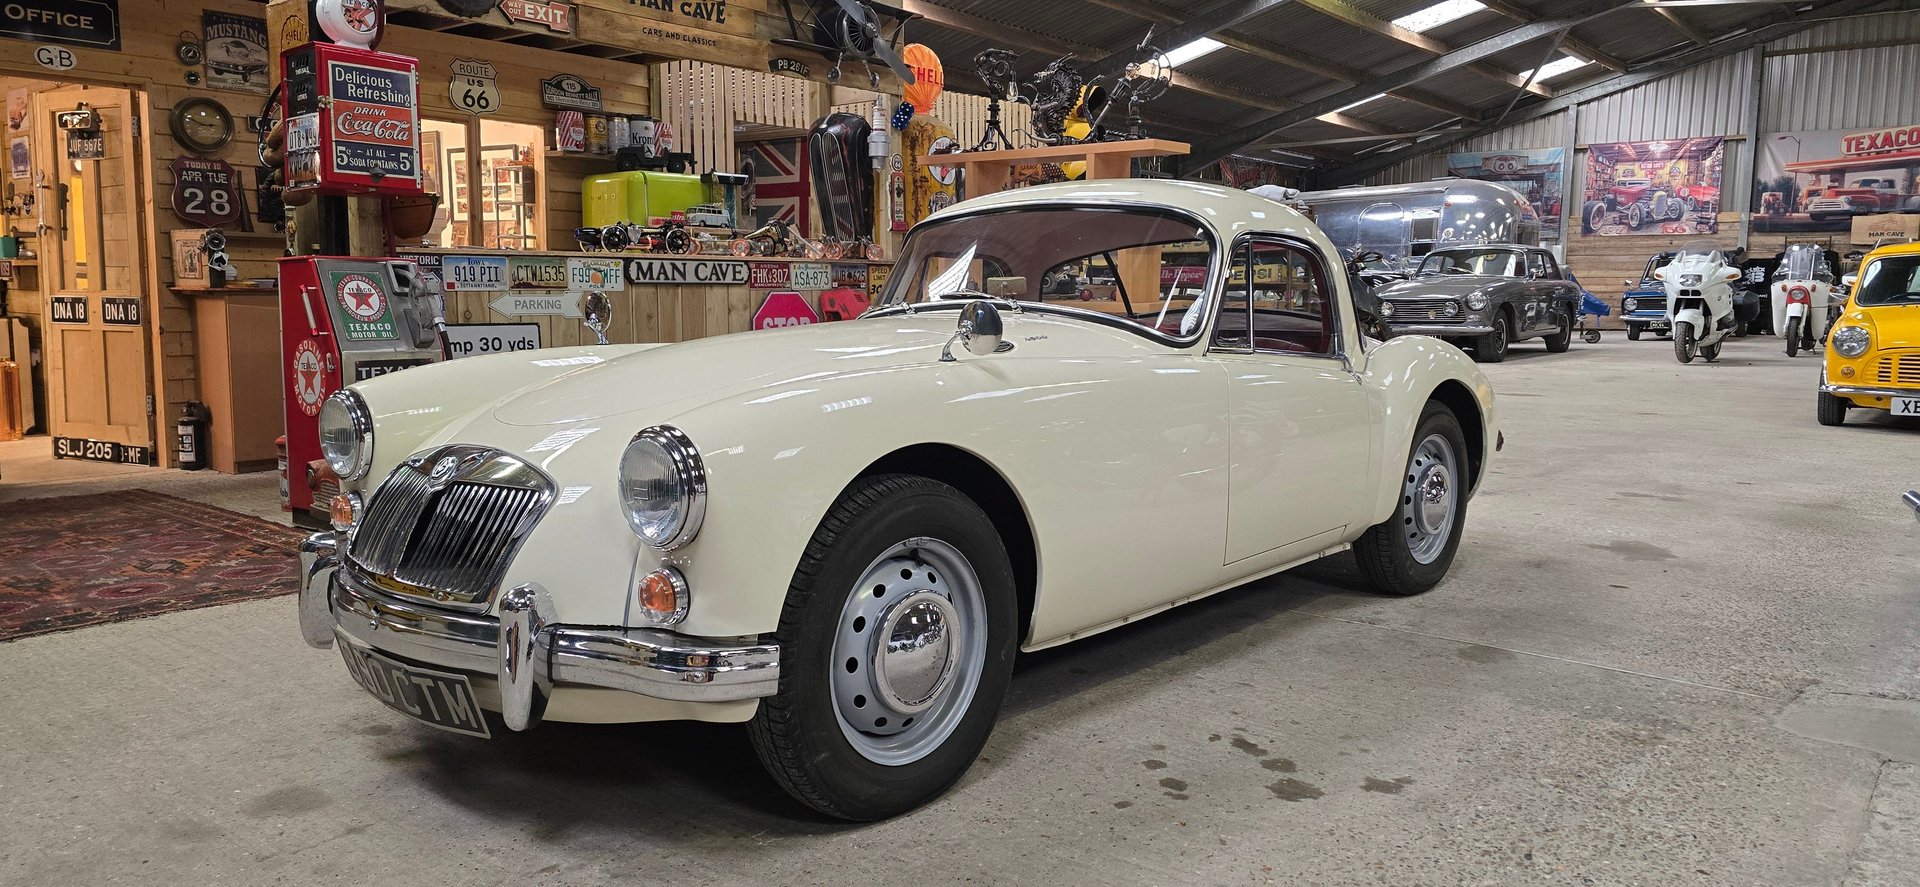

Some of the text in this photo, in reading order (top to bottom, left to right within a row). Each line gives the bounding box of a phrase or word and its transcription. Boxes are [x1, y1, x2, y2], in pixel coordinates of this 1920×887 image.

[4, 4, 94, 30] OFFICE
[525, 4, 564, 24] EXIT
[680, 0, 726, 24] CAVE
[206, 24, 267, 48] MUSTANG
[286, 29, 302, 42] SHELL
[642, 27, 717, 46] CARS AND CLASSICS
[37, 48, 73, 68] GB
[778, 59, 788, 70] PB
[335, 67, 392, 88] Delicious
[459, 64, 490, 76] ROUTE
[467, 78, 484, 88] US
[566, 82, 576, 90] 115
[348, 83, 410, 107] Refreshing
[462, 88, 490, 110] 66
[354, 106, 387, 116] DRINK
[84, 138, 102, 152] 567E
[1844, 127, 1920, 153] TEXACO
[366, 149, 374, 157] AT
[376, 150, 386, 158] ALL
[184, 160, 221, 170] TODAY IS
[350, 158, 398, 170] SODA FONTAINS
[182, 170, 228, 184] APR TUE
[184, 188, 230, 216] 28
[400, 255, 440, 265] TORIC
[454, 266, 500, 282] 919 PII
[635, 262, 744, 282] MAN CAVE
[752, 268, 789, 284] FHK 307
[794, 270, 830, 286] ASA-873
[1162, 270, 1172, 279] Dr
[1228, 268, 1272, 280] ESI
[54, 302, 84, 319] DNA 18
[105, 304, 137, 320] DNA 18
[514, 300, 562, 310] PARKING
[349, 323, 392, 331] TEXACO
[479, 337, 502, 352] 30
[508, 336, 534, 352] yds
[294, 340, 324, 369] GASOLINE
[358, 365, 417, 379] TEX
[294, 384, 326, 415] MOTOR OIL
[58, 439, 84, 456] SLJ
[86, 442, 112, 460] 205
[392, 669, 478, 729] CTM
